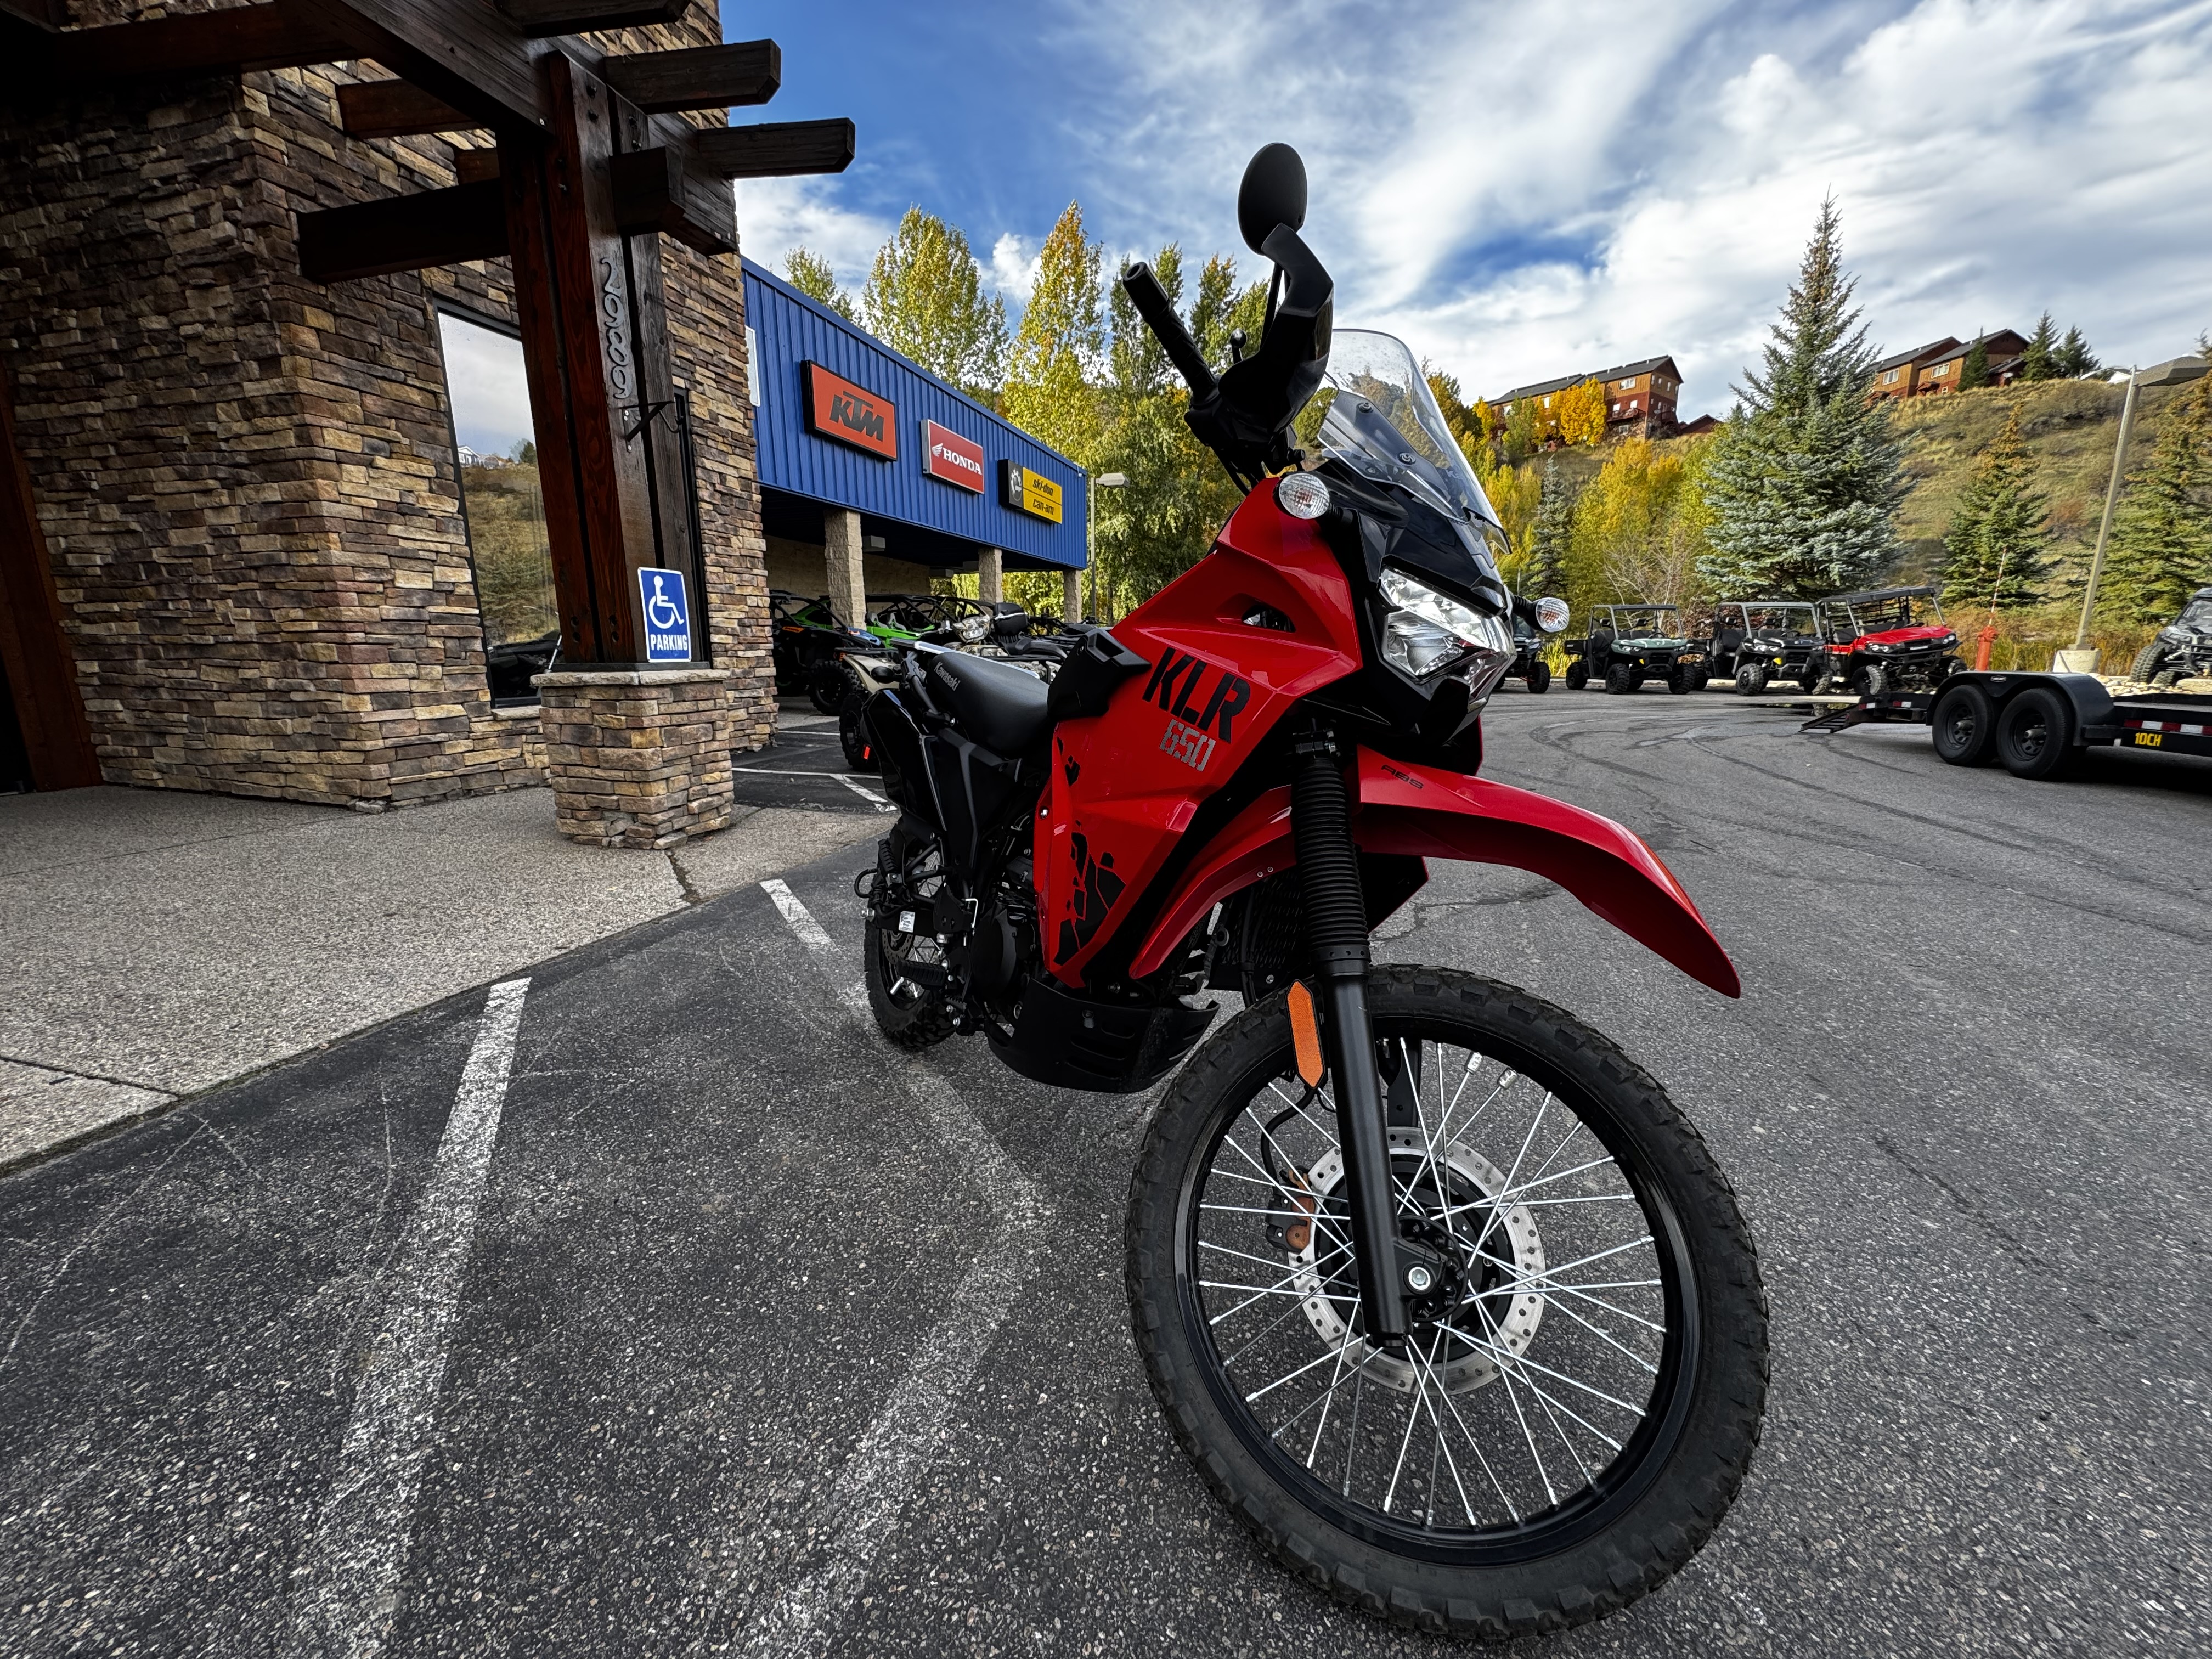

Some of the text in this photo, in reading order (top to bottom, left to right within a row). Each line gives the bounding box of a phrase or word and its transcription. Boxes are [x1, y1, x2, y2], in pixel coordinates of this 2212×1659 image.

[601, 257, 631, 399] 2989
[830, 390, 884, 442] KTM
[943, 447, 982, 476] HONDA
[1032, 479, 1053, 496] ski-doo
[1033, 499, 1054, 515] can-am
[650, 634, 687, 651] PARKING
[934, 661, 961, 691] Kawasaki
[1142, 646, 1250, 744] KLR
[1159, 719, 1216, 772] 650
[2135, 732, 2162, 747] 10CH
[1381, 764, 1424, 789] ABS
